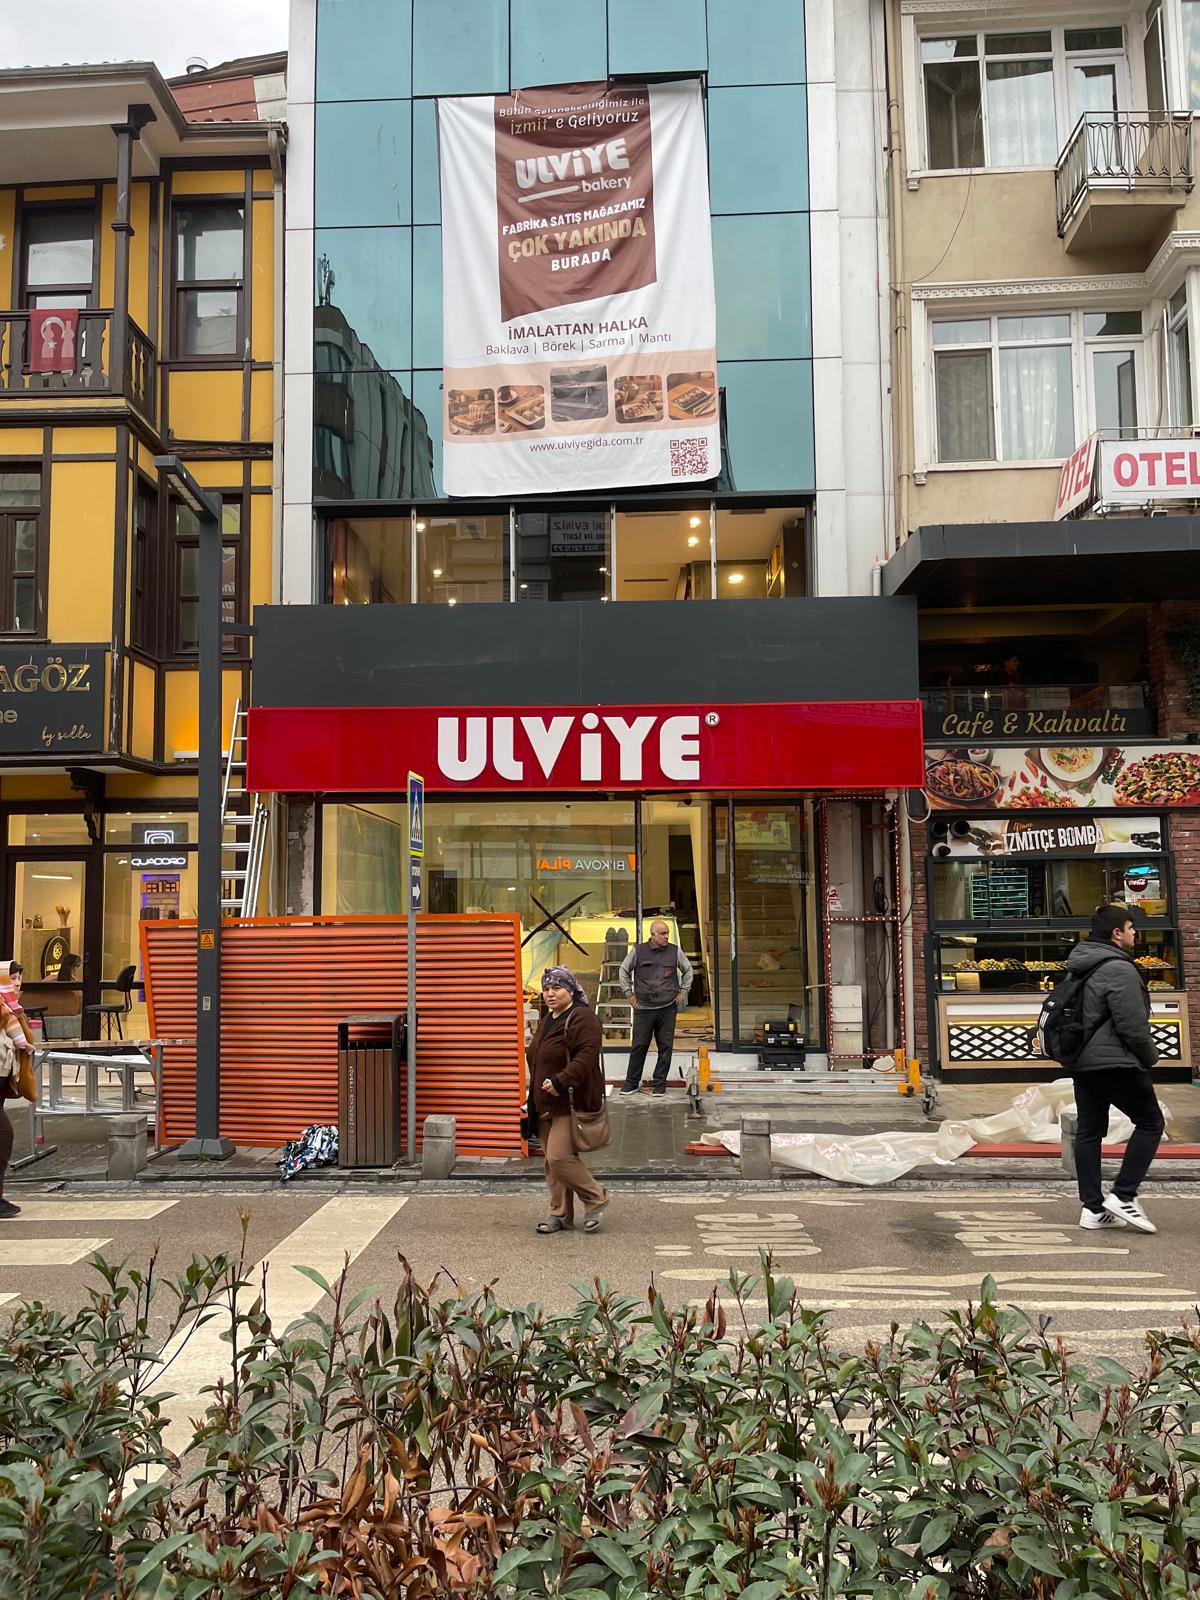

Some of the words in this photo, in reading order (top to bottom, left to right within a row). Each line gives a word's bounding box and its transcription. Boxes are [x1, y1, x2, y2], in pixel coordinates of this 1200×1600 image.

[631, 96, 645, 107] ile
[568, 110, 639, 128] Geliyoruz
[582, 175, 632, 194] bakery
[502, 215, 549, 236] FABRİKA
[550, 210, 582, 229] SATIŞ
[583, 197, 646, 219] MAĞAZAMIZ
[508, 233, 552, 263] ÇOK
[553, 216, 647, 252] YAKINDA
[551, 247, 612, 272] BURADA
[508, 322, 594, 341] İMALATTAN
[598, 316, 648, 335] HALKA
[486, 343, 529, 356] Baklava
[542, 338, 576, 353] Börek
[589, 336, 625, 350] Sarma
[639, 332, 672, 343] Mantı
[529, 435, 644, 453] www.ulviyegida.com.tr
[1057, 438, 1094, 509] OTEL
[942, 710, 994, 738] Cafe
[1002, 712, 1018, 734] &
[1024, 708, 1127, 734] Kahvaltı
[1057, 824, 1105, 848] BOMBA
[131, 857, 187, 867] QUADDRO
